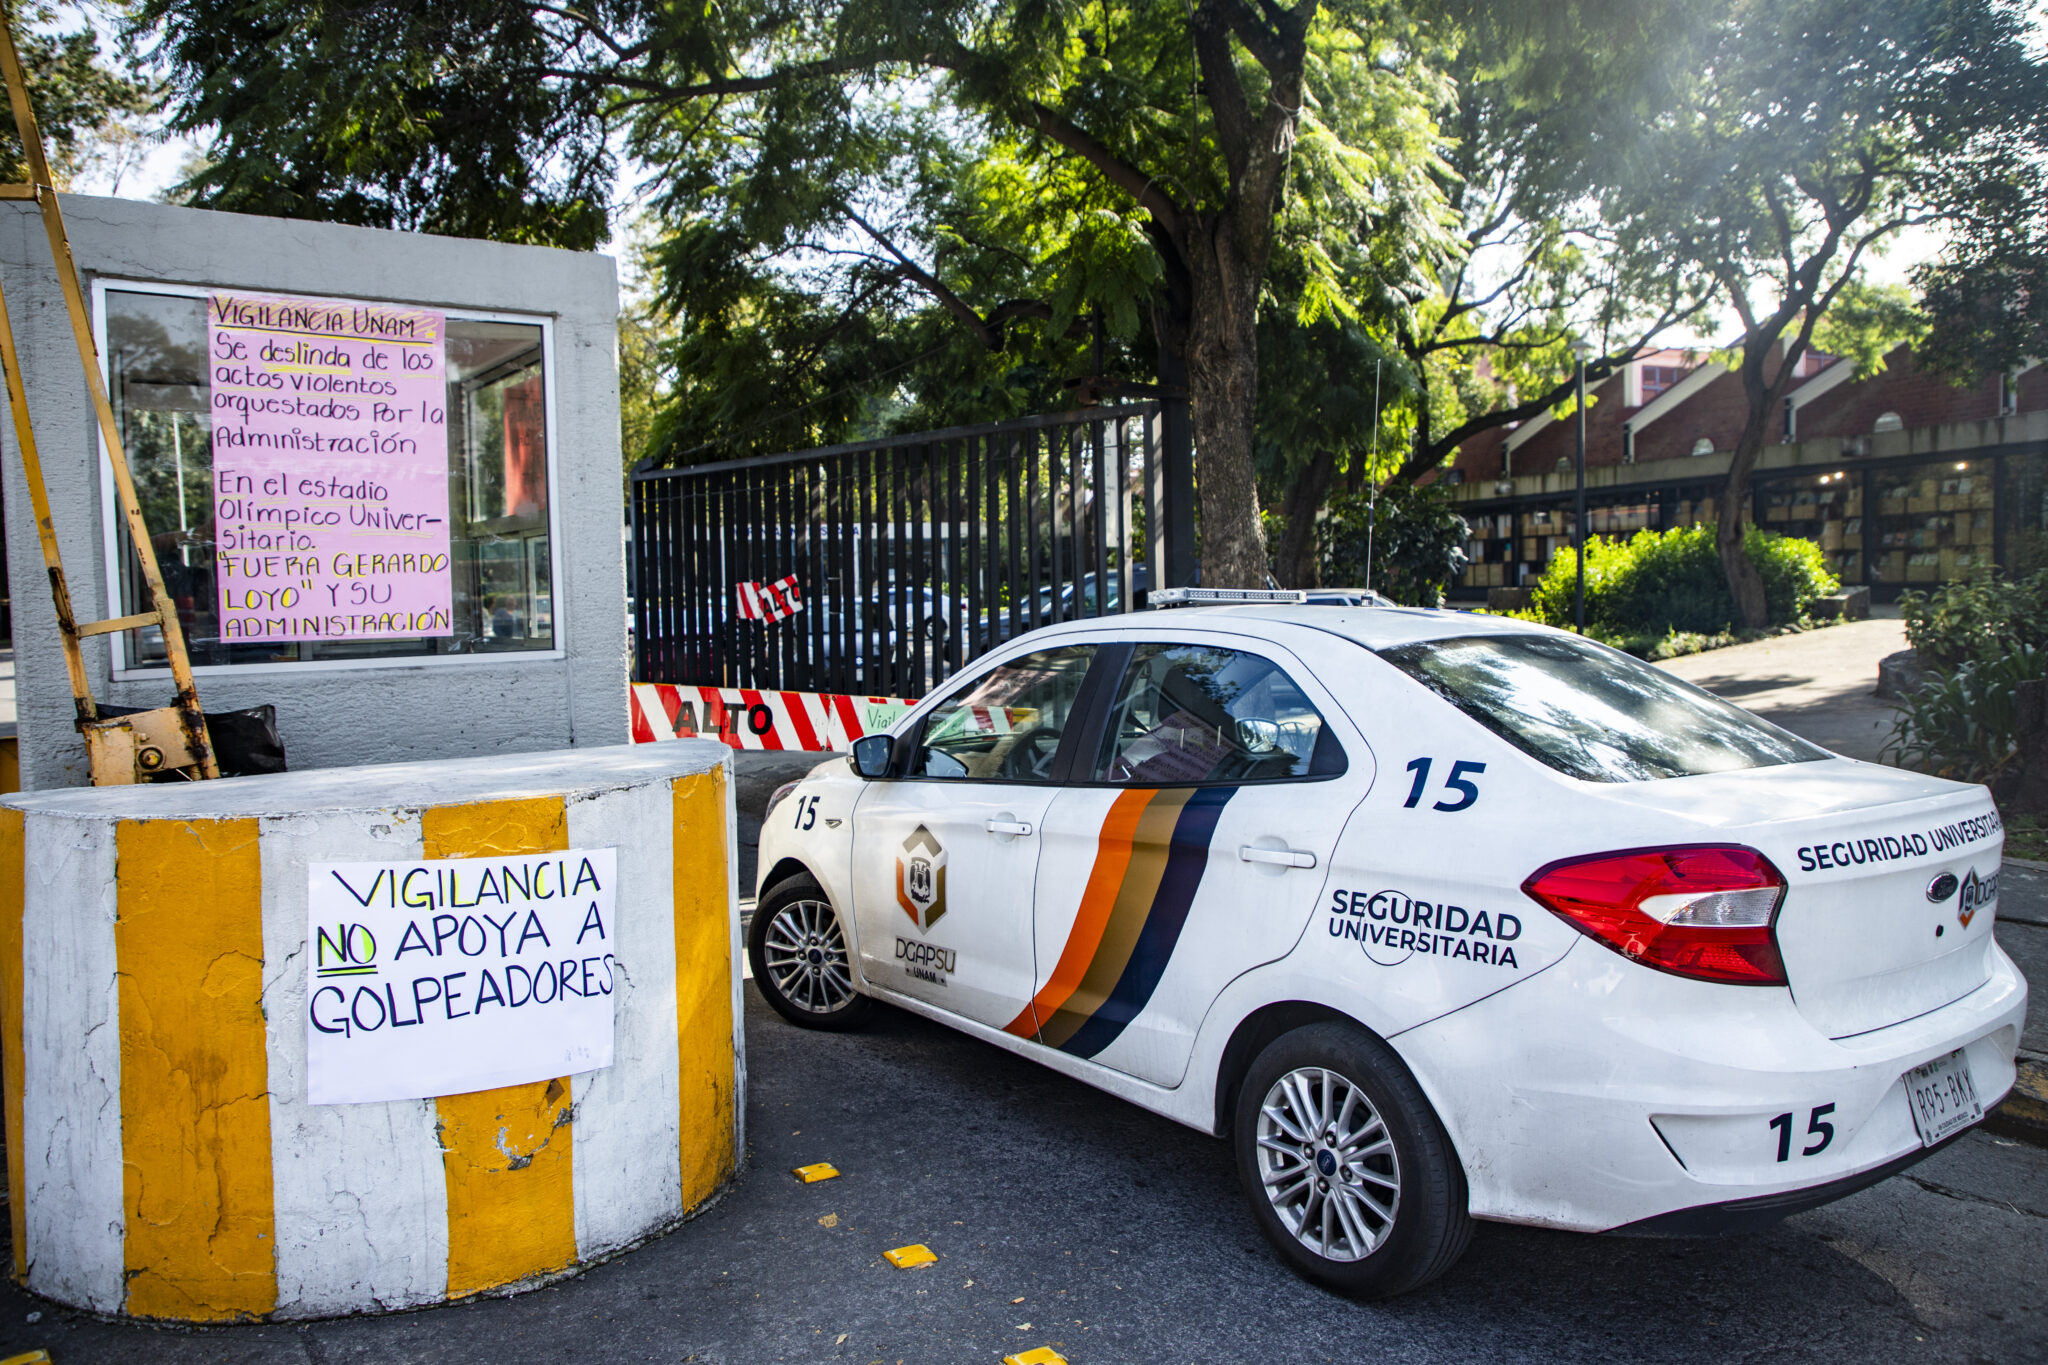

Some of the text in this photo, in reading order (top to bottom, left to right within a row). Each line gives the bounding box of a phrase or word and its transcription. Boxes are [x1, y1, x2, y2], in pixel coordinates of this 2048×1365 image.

[213, 296, 415, 337] VIGILANCIA UNAM
[215, 332, 433, 370] Se deslinda de los
[215, 365, 397, 396] actos violentos
[214, 392, 360, 425] orquestados
[422, 400, 444, 424] la
[216, 426, 416, 454] Administración
[219, 470, 388, 501] En el estadio
[219, 499, 341, 530] Olímpico
[332, 552, 449, 578] GERARDO
[225, 579, 392, 611] LOYO" Y SU
[762, 582, 801, 617] ALTO
[225, 605, 450, 638] ADMINISTRACIÓN
[672, 700, 773, 735] ALTO
[1403, 757, 1487, 812] 15
[794, 795, 821, 831] 15
[1797, 833, 1928, 872] SEGURIDAD
[331, 857, 602, 910] VIGILANCIA
[1331, 889, 1522, 941] SEGURIDAD
[317, 901, 606, 967] NO APOYA A
[1329, 917, 1519, 969] UNIVERSITARIA
[895, 937, 956, 974] DGAPSU
[913, 966, 937, 984] UNAM
[310, 953, 614, 1039] GOLPEADORES
[1916, 1067, 1976, 1124] R95-BKX
[1769, 1102, 1835, 1163] 15
